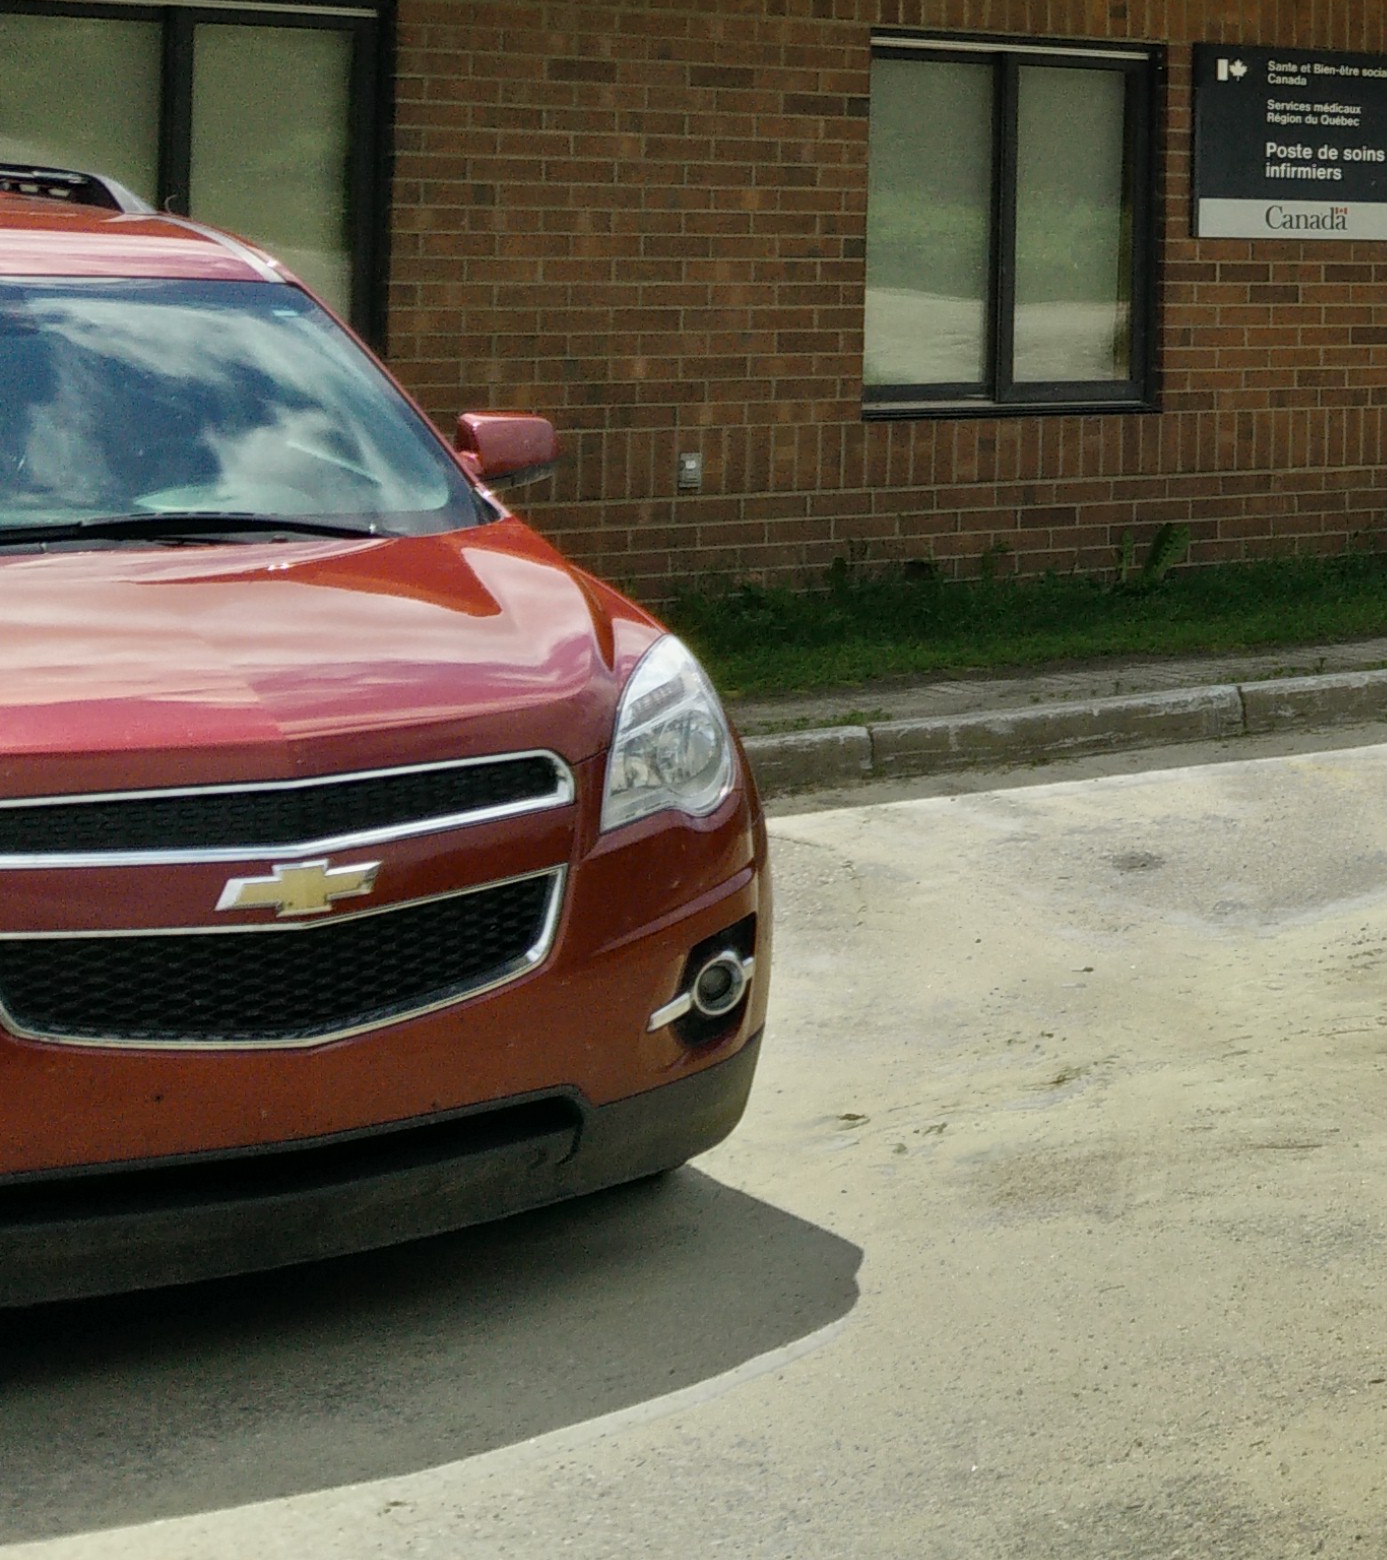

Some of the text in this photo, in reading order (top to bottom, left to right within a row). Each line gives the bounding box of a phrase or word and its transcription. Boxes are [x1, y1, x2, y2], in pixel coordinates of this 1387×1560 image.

[1300, 63, 1311, 73] et
[1267, 73, 1307, 86] Canada
[1267, 99, 1362, 114] Services médicaux
[1266, 112, 1360, 126] Région du Québec
[1265, 142, 1385, 162] Poste de soins
[1265, 162, 1342, 180] infirmiers
[1265, 205, 1347, 230] Canada
